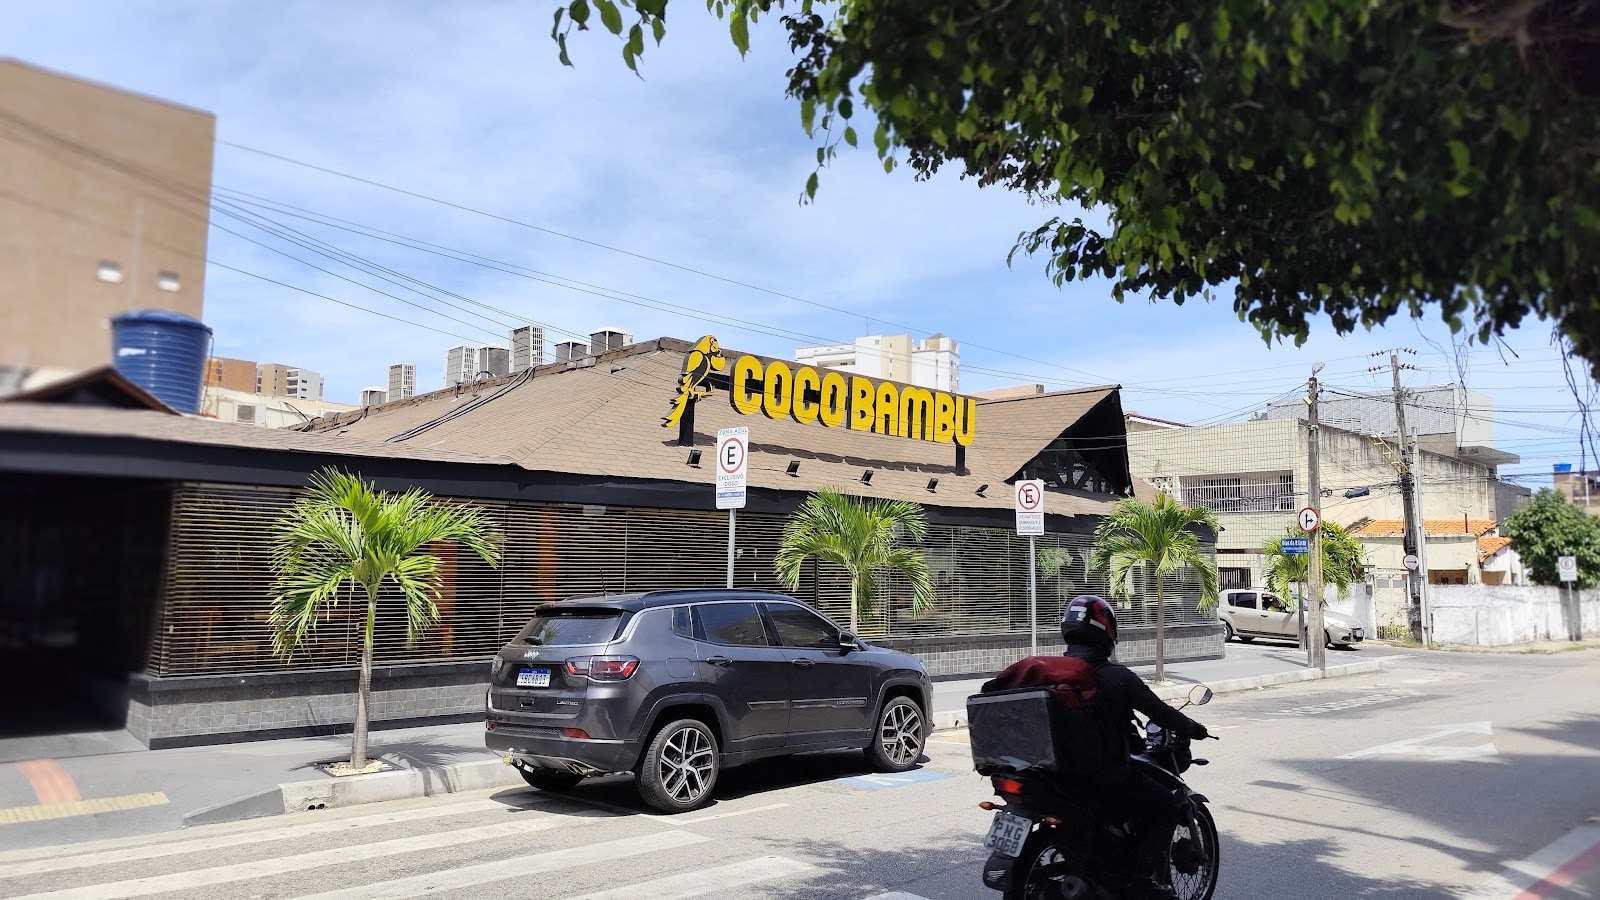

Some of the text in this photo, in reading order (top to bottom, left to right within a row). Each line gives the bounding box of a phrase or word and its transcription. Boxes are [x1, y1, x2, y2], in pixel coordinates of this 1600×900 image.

[732, 354, 976, 446] COCO BAMBU
[727, 446, 736, 465] E
[718, 473, 745, 481] EXCLUSIVO
[1026, 489, 1032, 503] E
[993, 821, 1024, 841] PNG
[987, 834, 1019, 855] 3068
